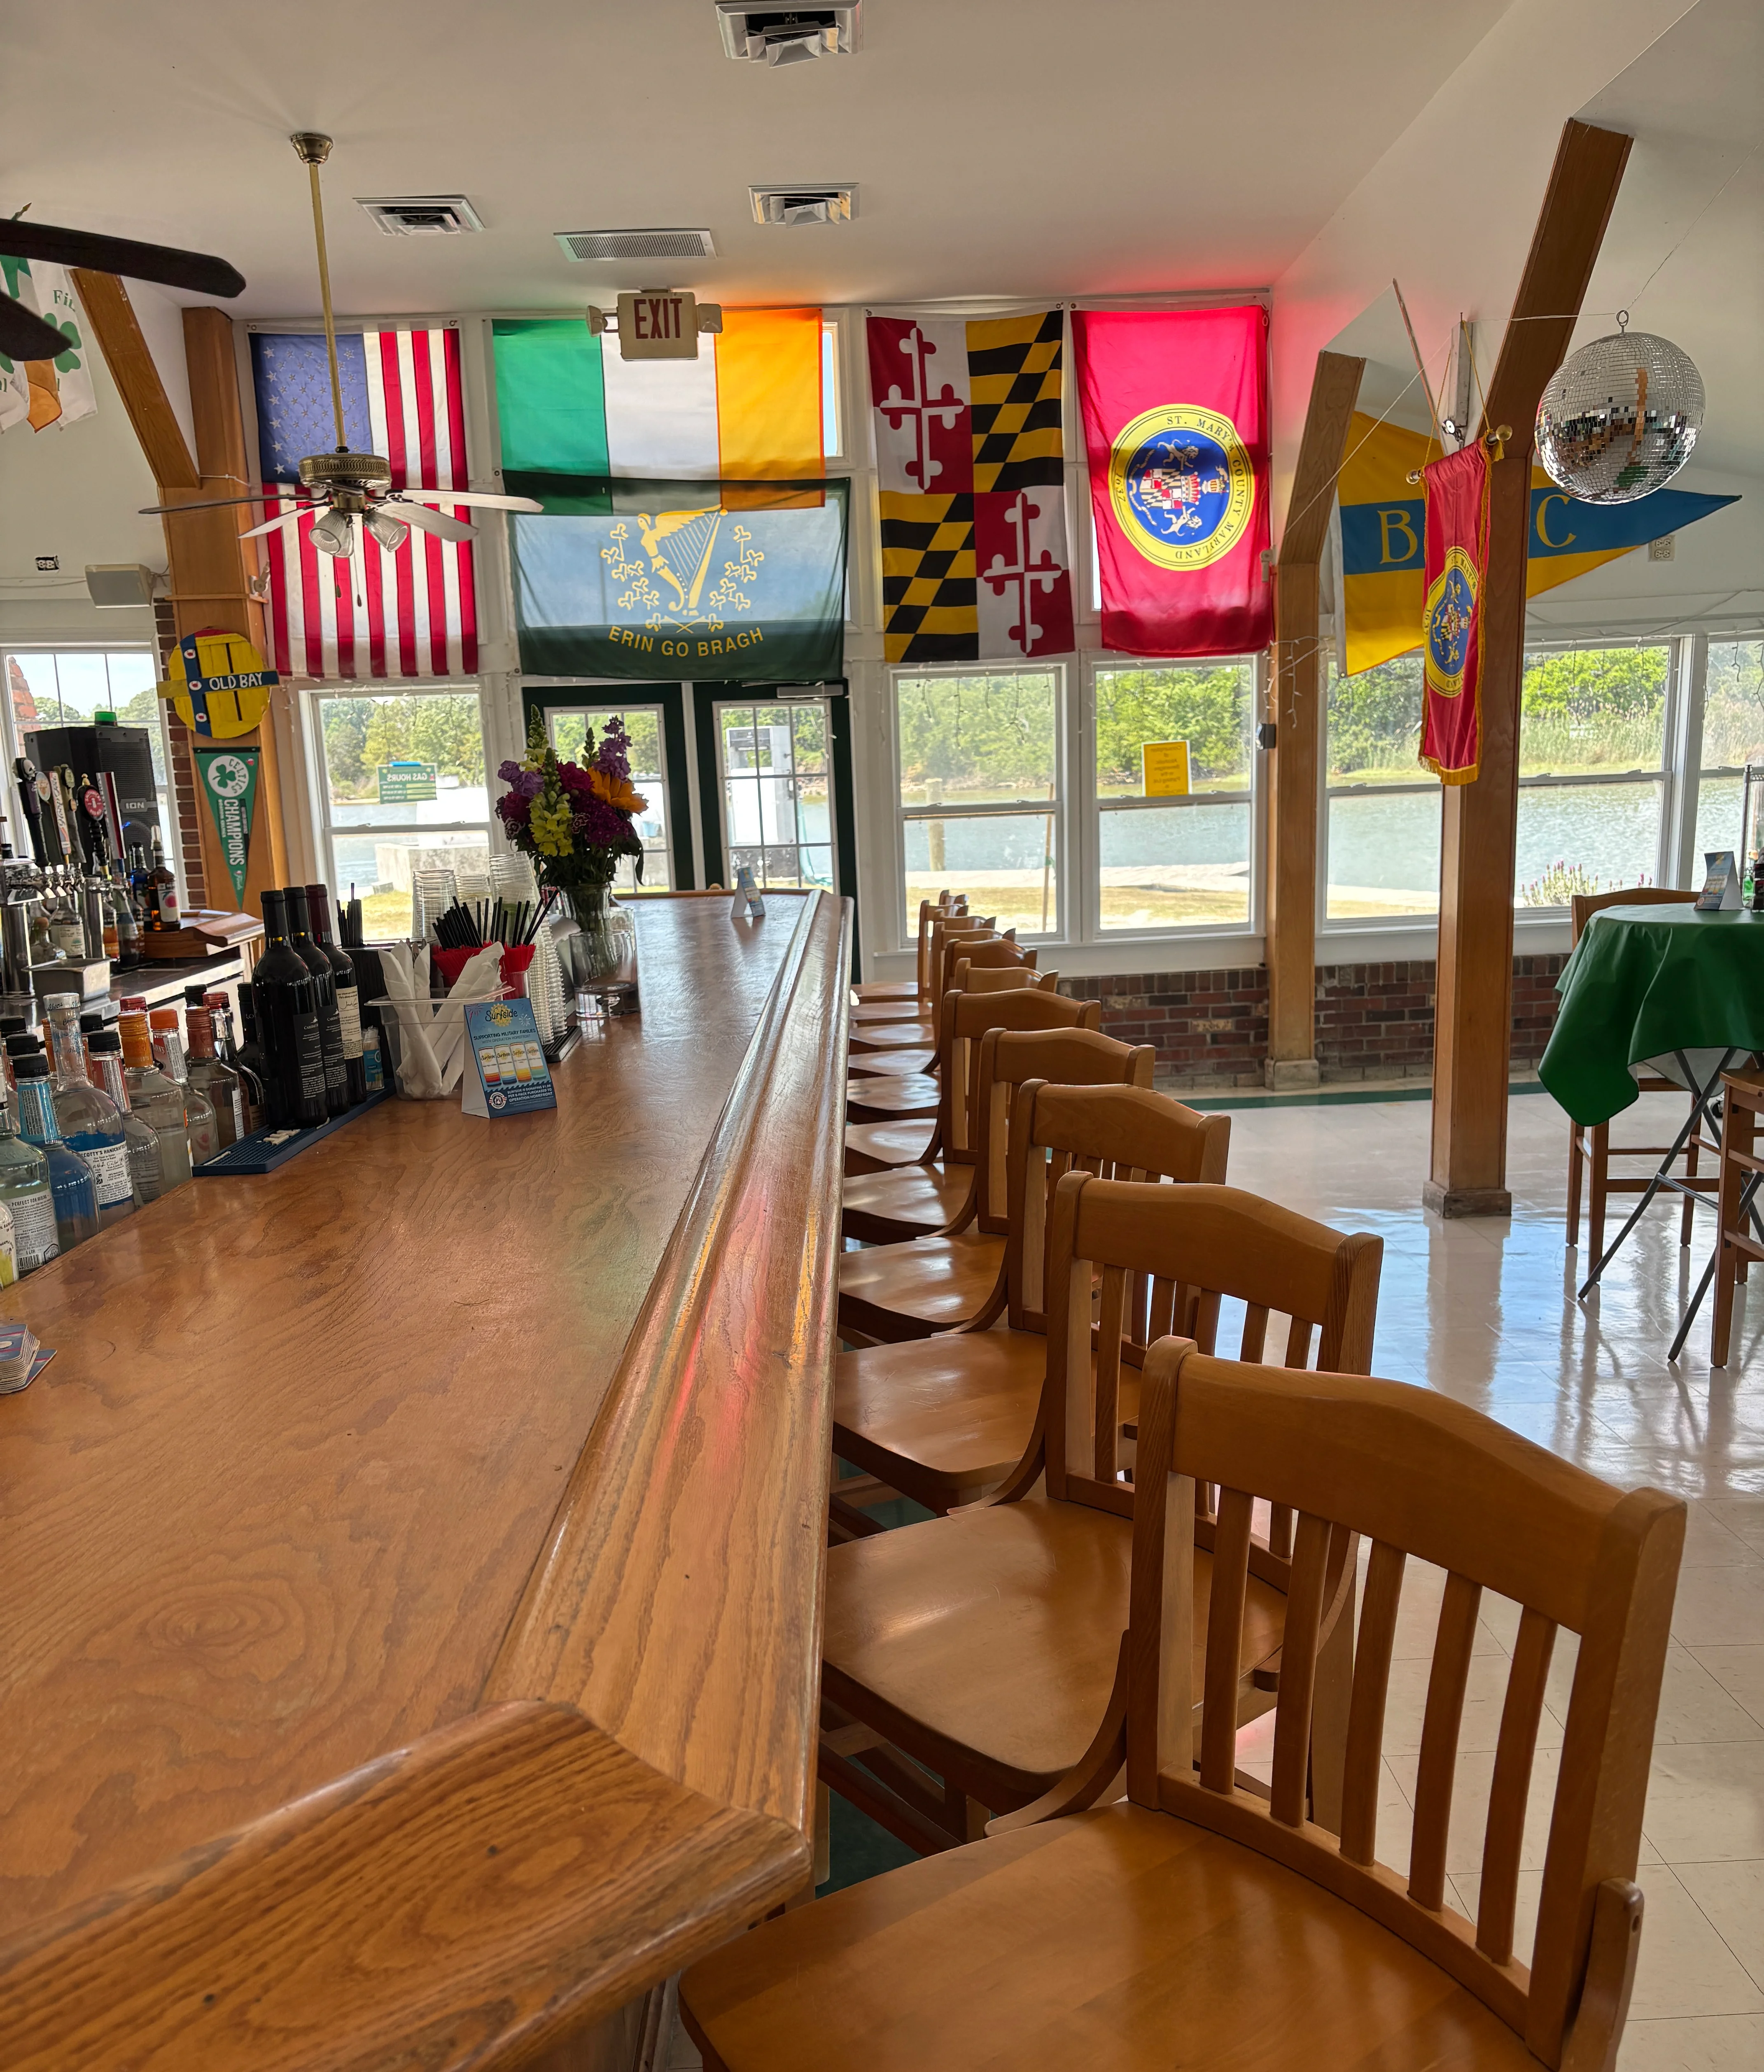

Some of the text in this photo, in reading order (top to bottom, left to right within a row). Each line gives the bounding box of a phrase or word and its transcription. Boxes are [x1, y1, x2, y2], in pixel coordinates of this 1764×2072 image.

[634, 298, 682, 339] EXIT
[1167, 416, 1187, 424] ST.
[1115, 473, 1126, 502] 1637
[1232, 459, 1246, 516] COUNTY
[1176, 522, 1234, 559] MARYLAND
[1377, 494, 1577, 564] B C
[608, 626, 763, 657] ERIN GO BRAGH
[209, 672, 262, 690] OLD BAY
[229, 758, 246, 793] CELTICS
[224, 799, 245, 865] CHAMPIONS
[485, 1007, 518, 1021] Surfside
